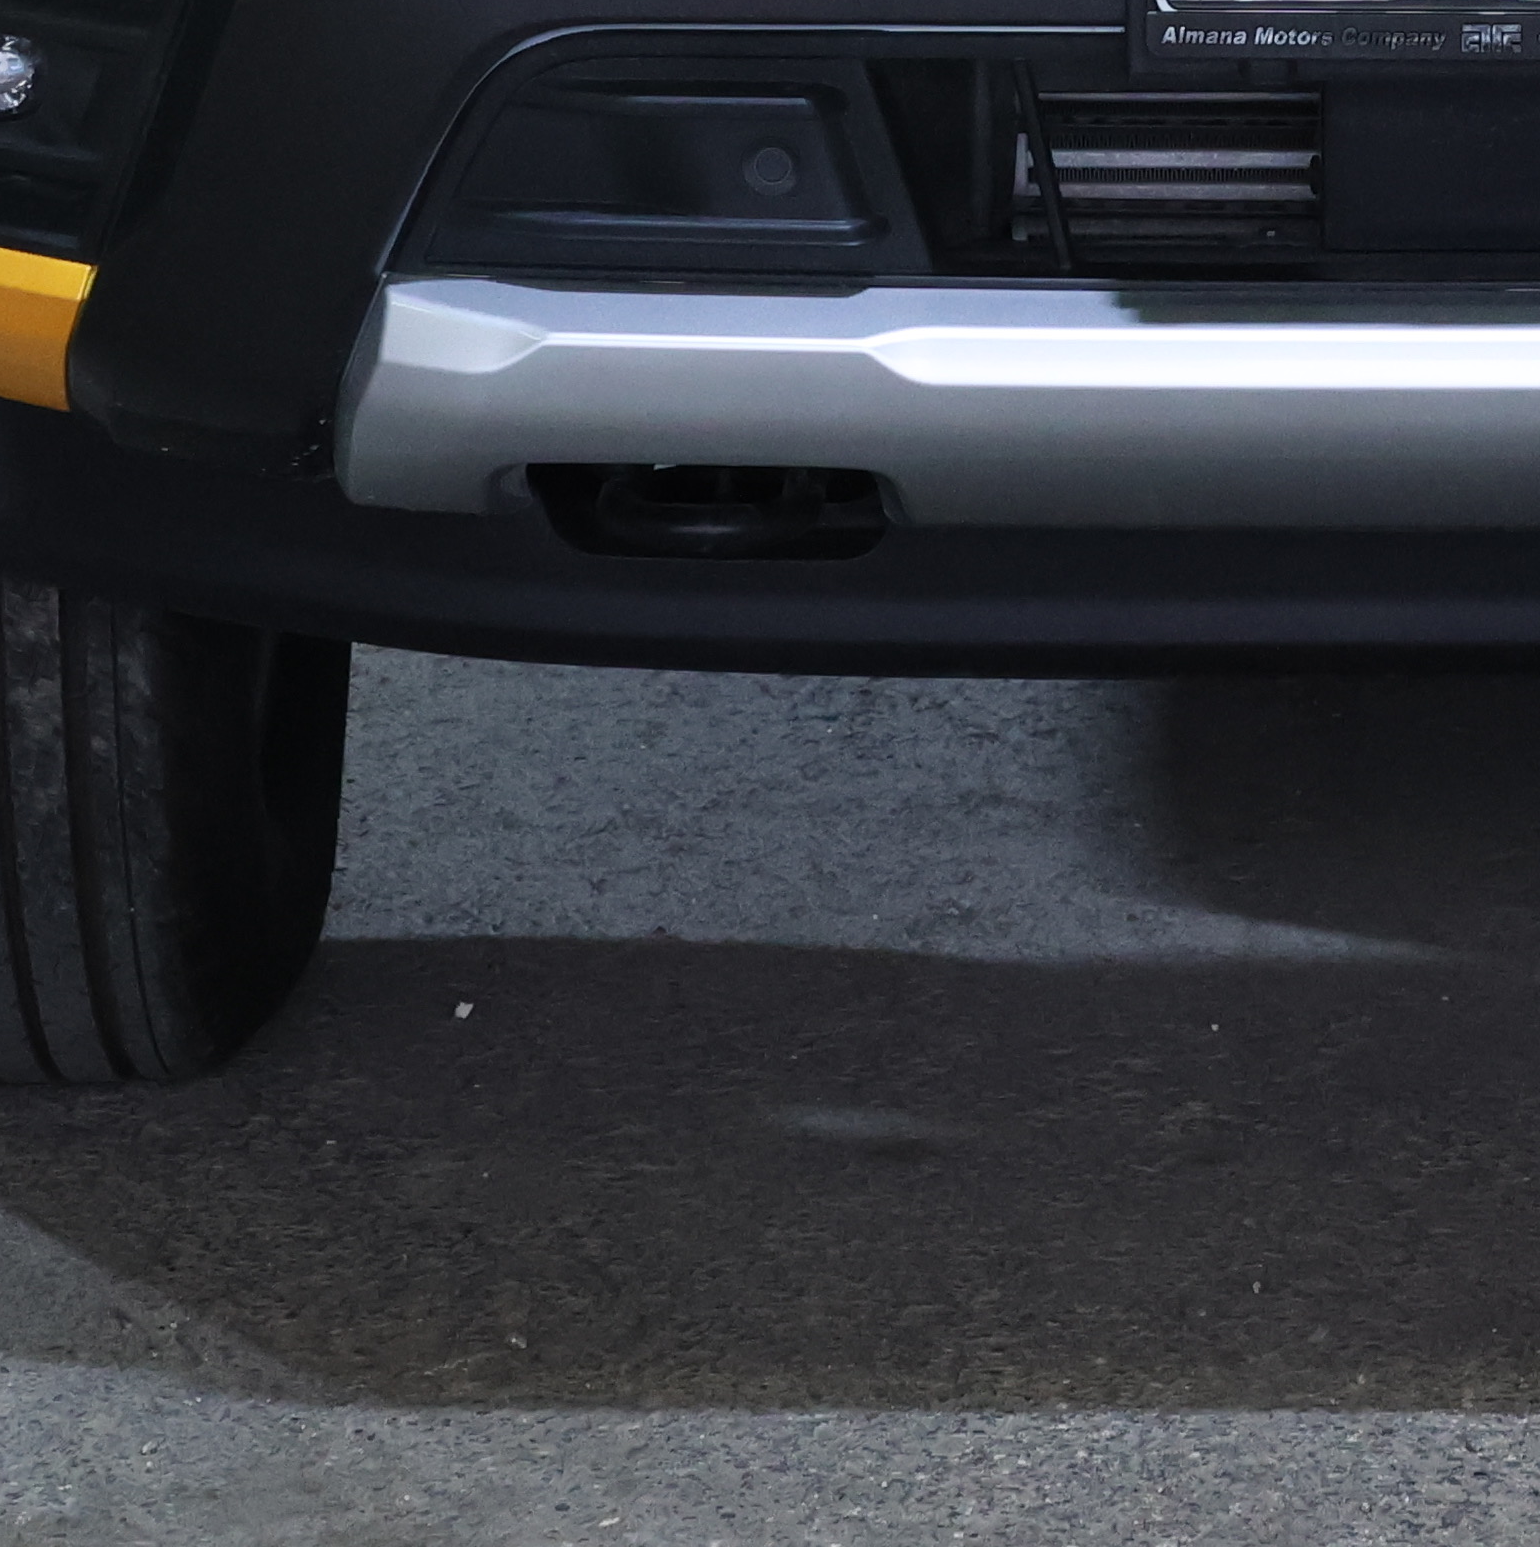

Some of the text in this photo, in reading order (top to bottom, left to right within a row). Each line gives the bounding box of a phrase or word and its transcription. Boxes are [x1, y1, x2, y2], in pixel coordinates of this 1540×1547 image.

[1161, 26, 1446, 52] Almana Motors Company
